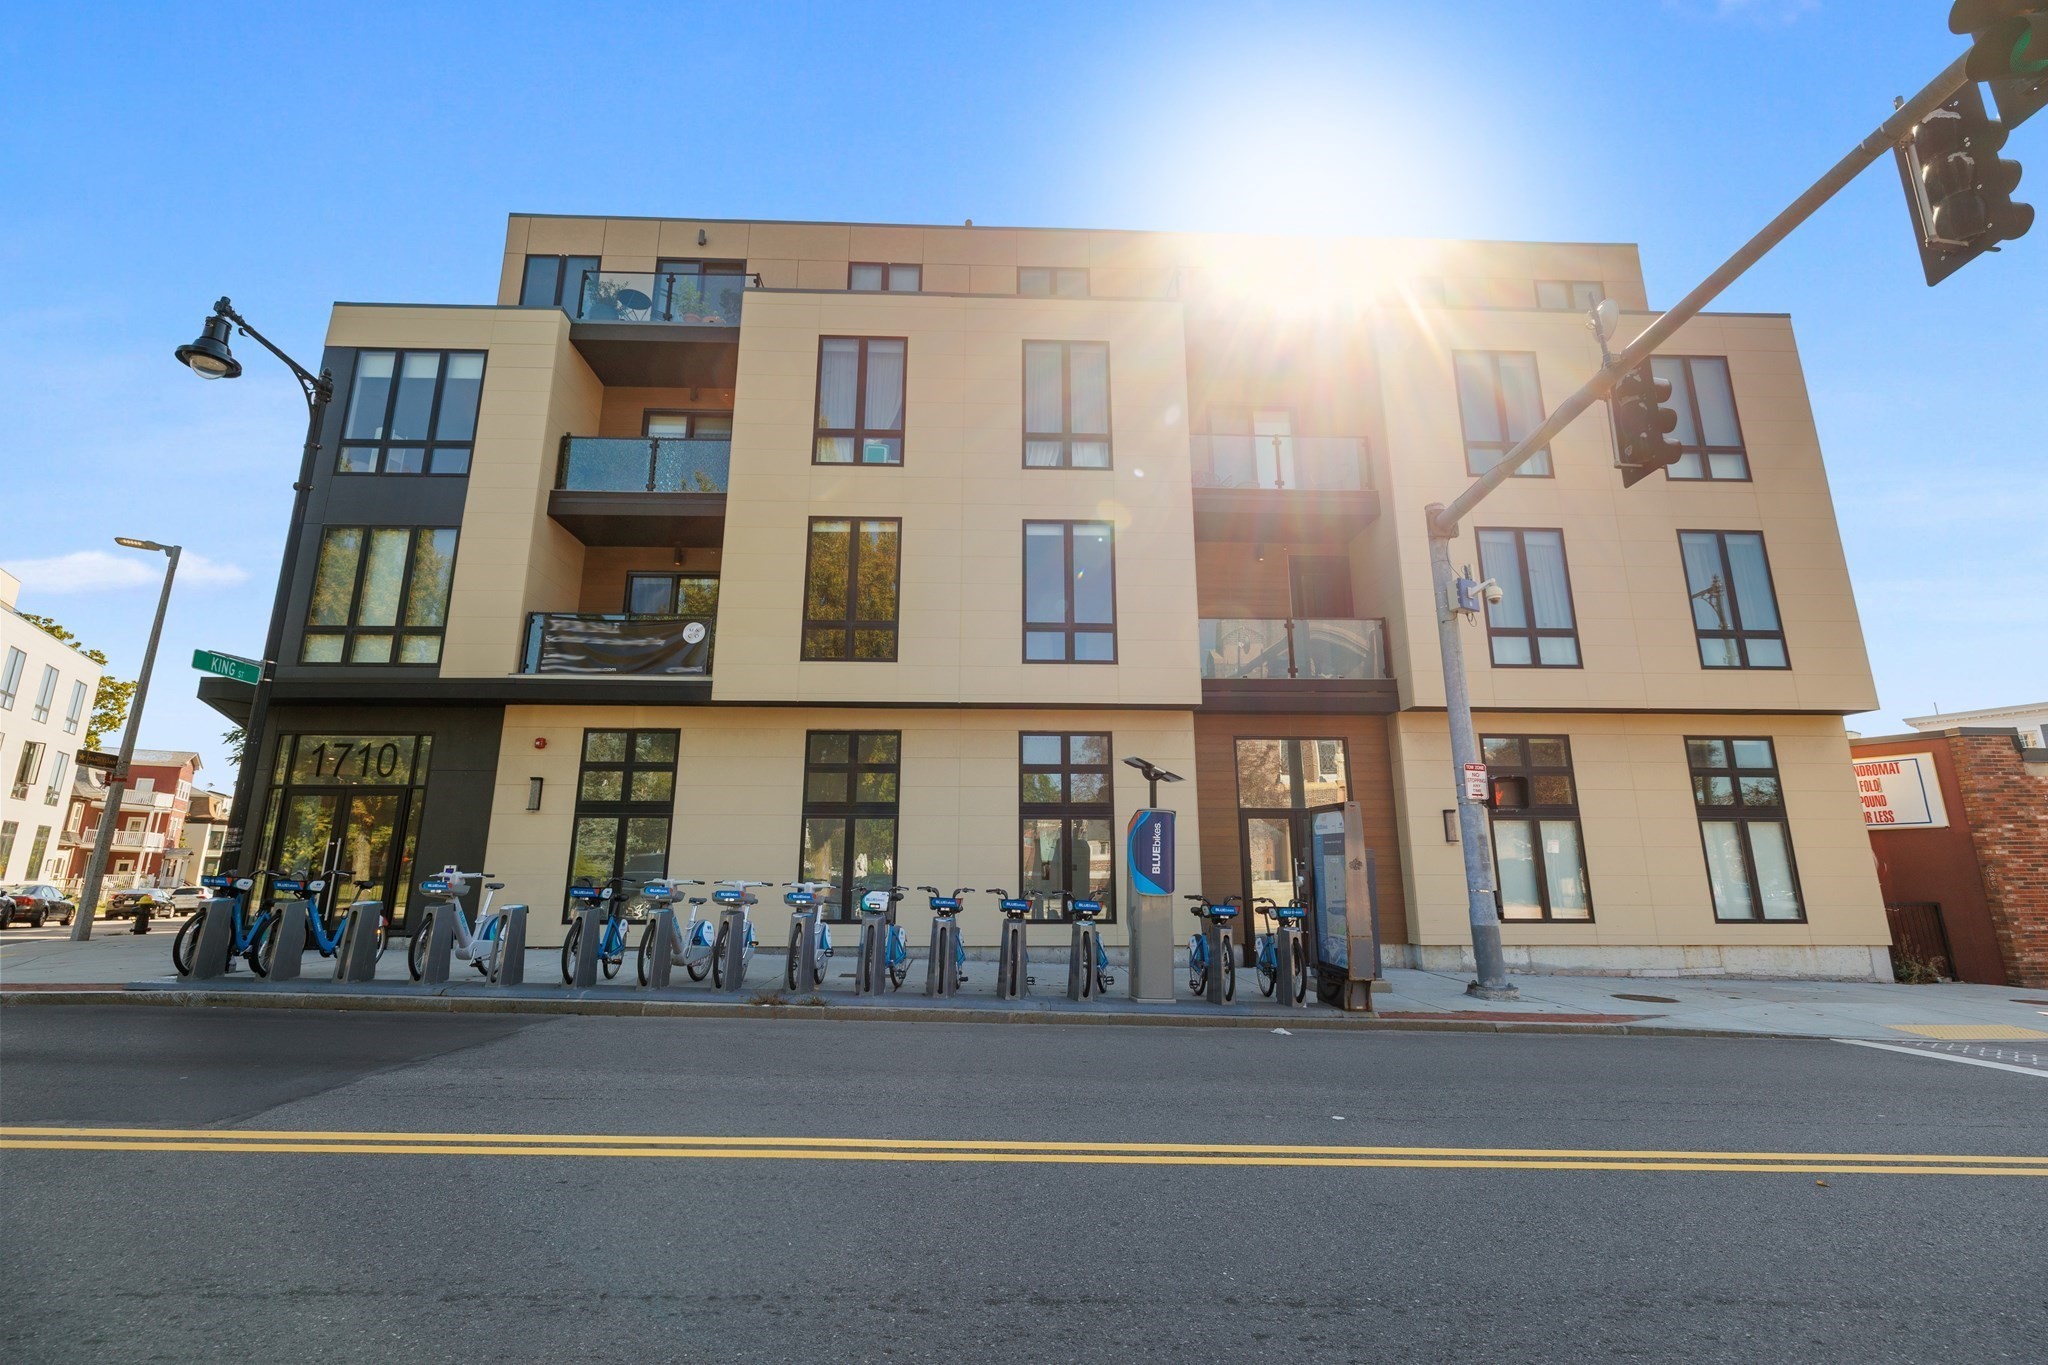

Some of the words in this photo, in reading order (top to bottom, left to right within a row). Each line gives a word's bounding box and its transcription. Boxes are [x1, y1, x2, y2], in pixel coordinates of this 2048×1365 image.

[211, 656, 236, 676] KING
[238, 670, 245, 678] ST
[312, 742, 398, 777] 1710
[1859, 779, 1880, 792] FOLD
[1874, 809, 1895, 823] LESS
[1152, 822, 1162, 875] BLUEbikes
